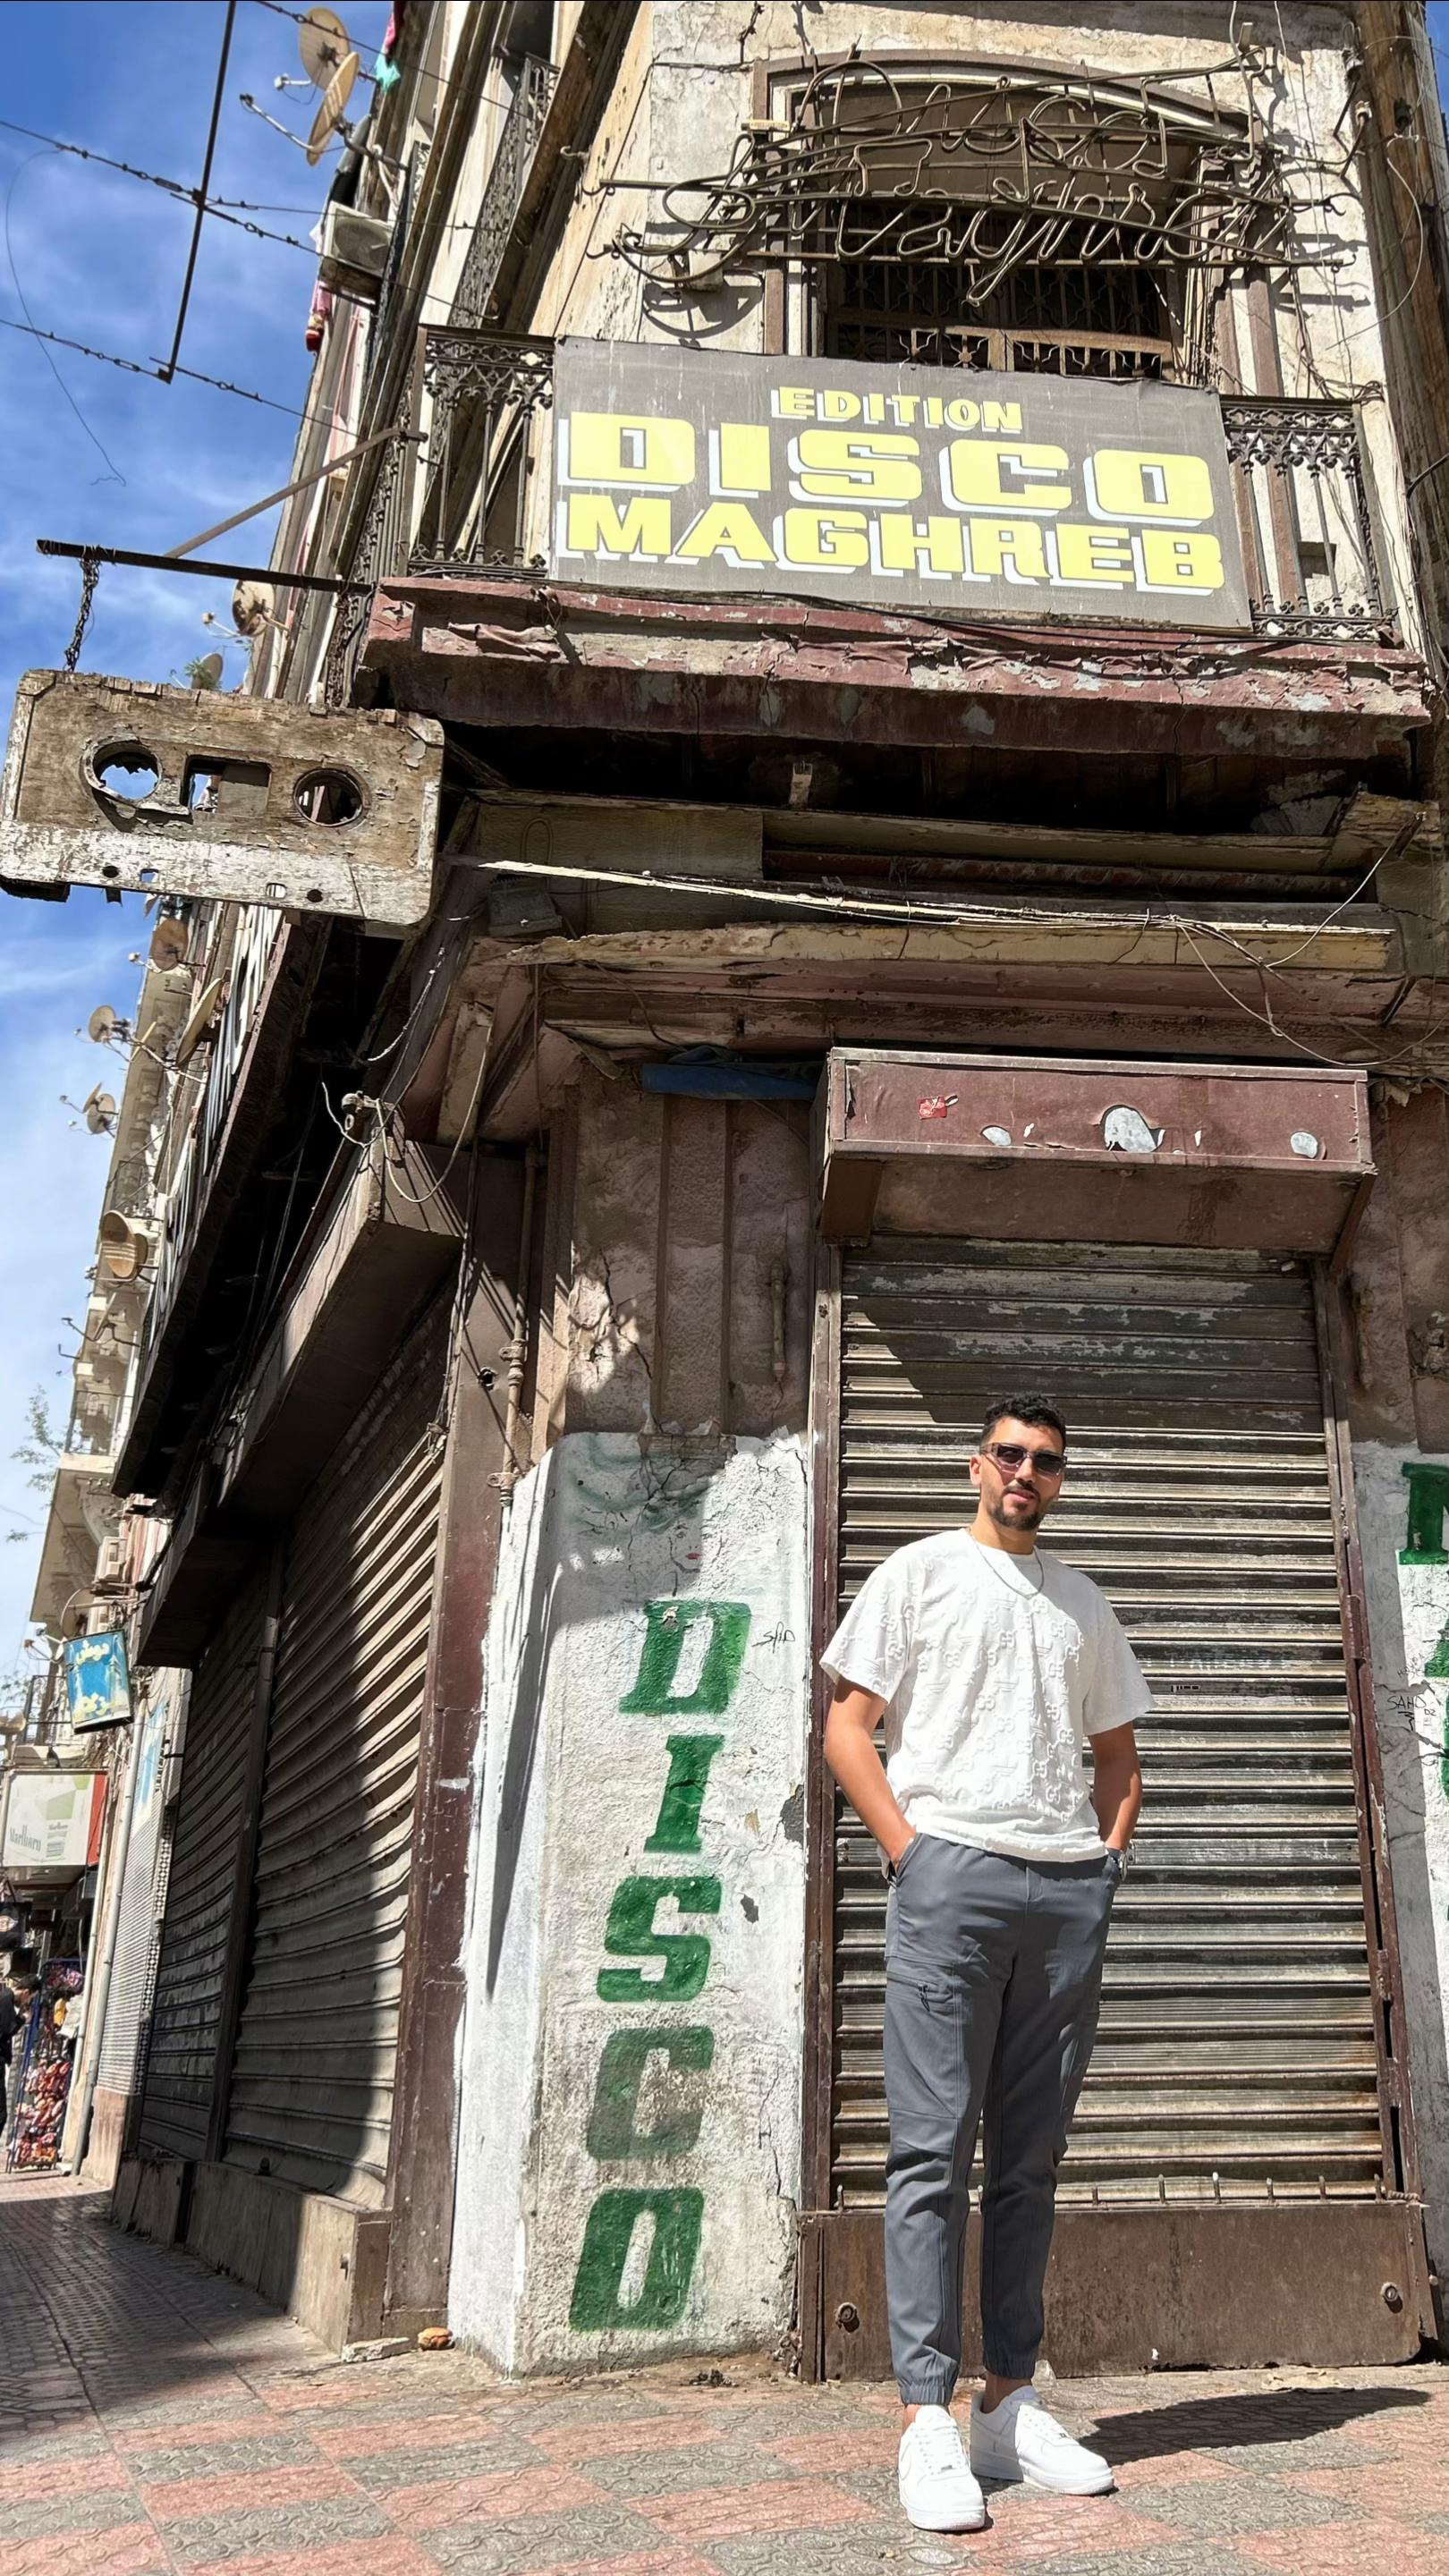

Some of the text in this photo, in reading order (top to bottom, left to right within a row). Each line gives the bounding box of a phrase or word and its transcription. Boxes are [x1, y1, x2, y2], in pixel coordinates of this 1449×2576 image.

[771, 386, 1022, 434] EDITION
[557, 411, 1215, 526] DISCO
[555, 493, 1225, 597] MAGHREB
[570, 1599, 752, 2332] DISCO
